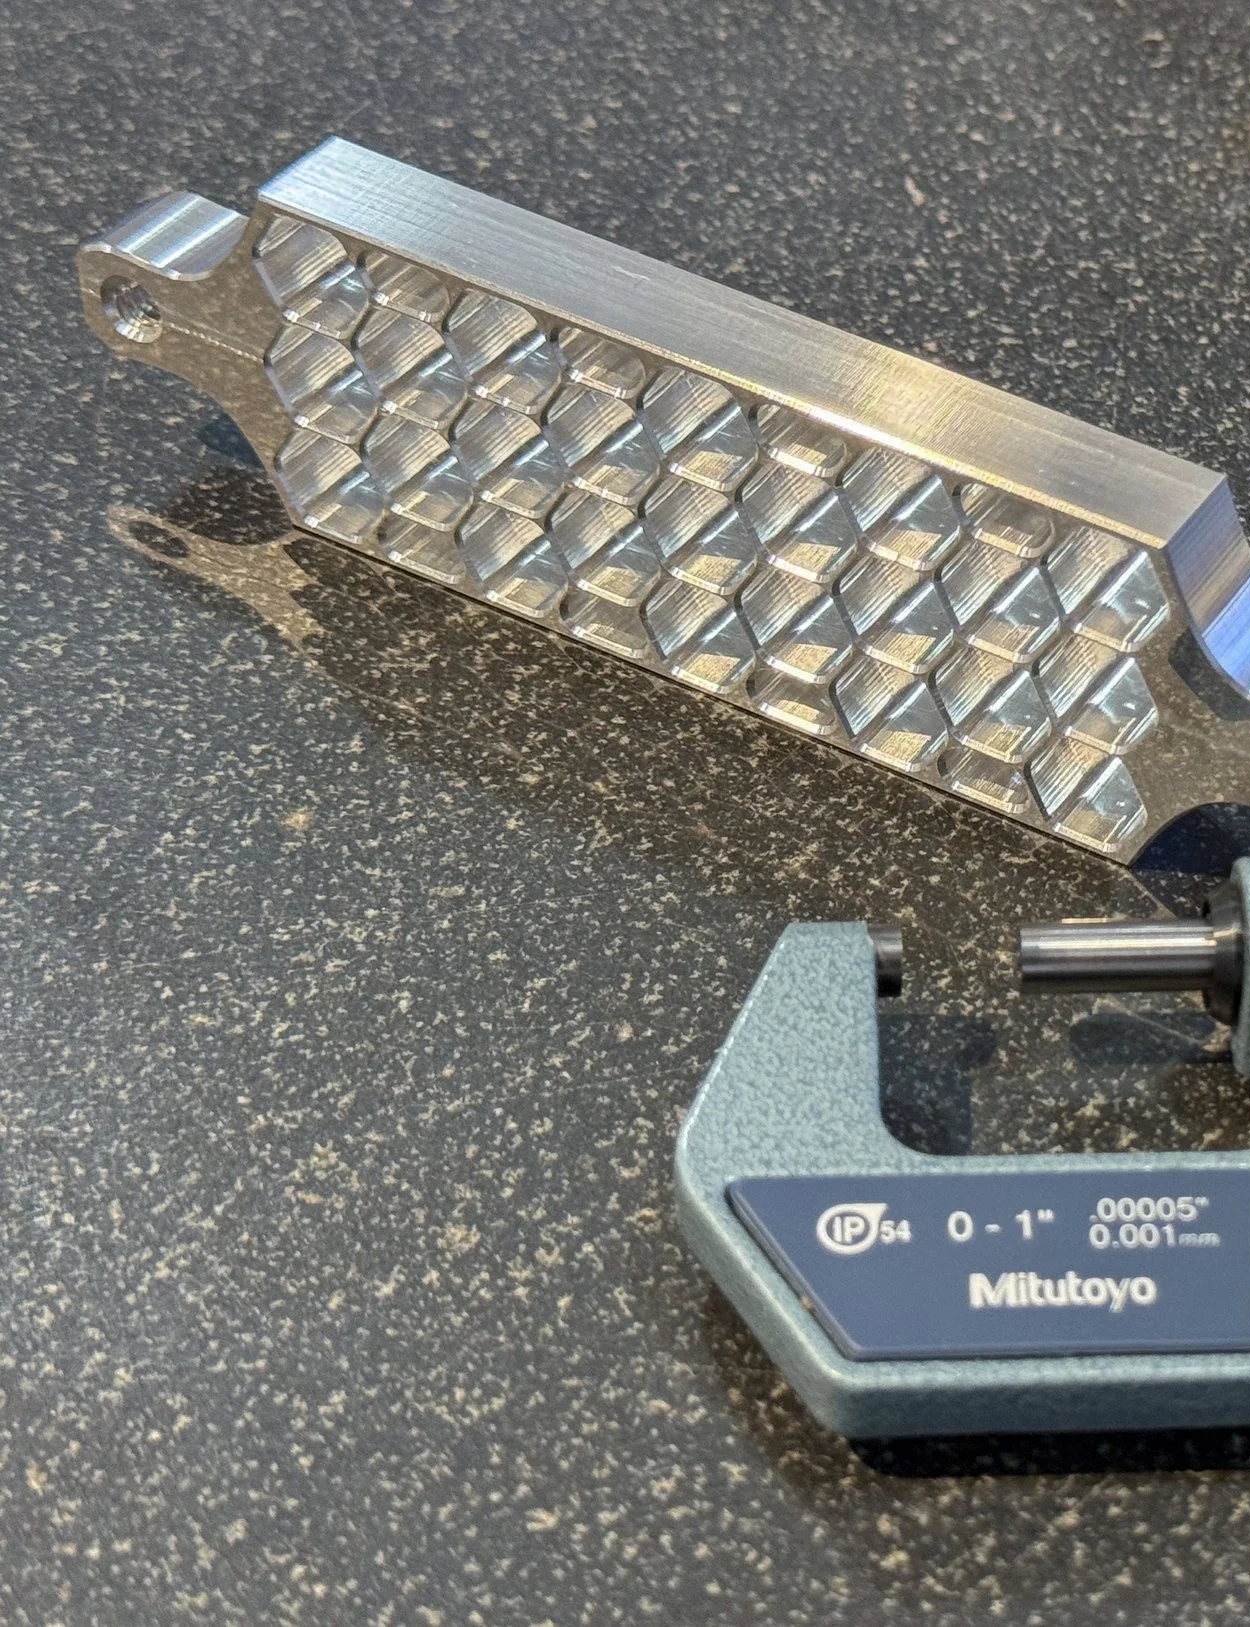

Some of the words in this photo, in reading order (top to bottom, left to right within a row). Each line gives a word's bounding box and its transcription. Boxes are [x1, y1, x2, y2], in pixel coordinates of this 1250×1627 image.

[832, 1213, 866, 1243] IP
[880, 1219, 912, 1243] 54
[947, 1210, 974, 1242] 0
[1014, 1208, 1056, 1240] 1"
[968, 1270, 1157, 1313] Mitutoyo
